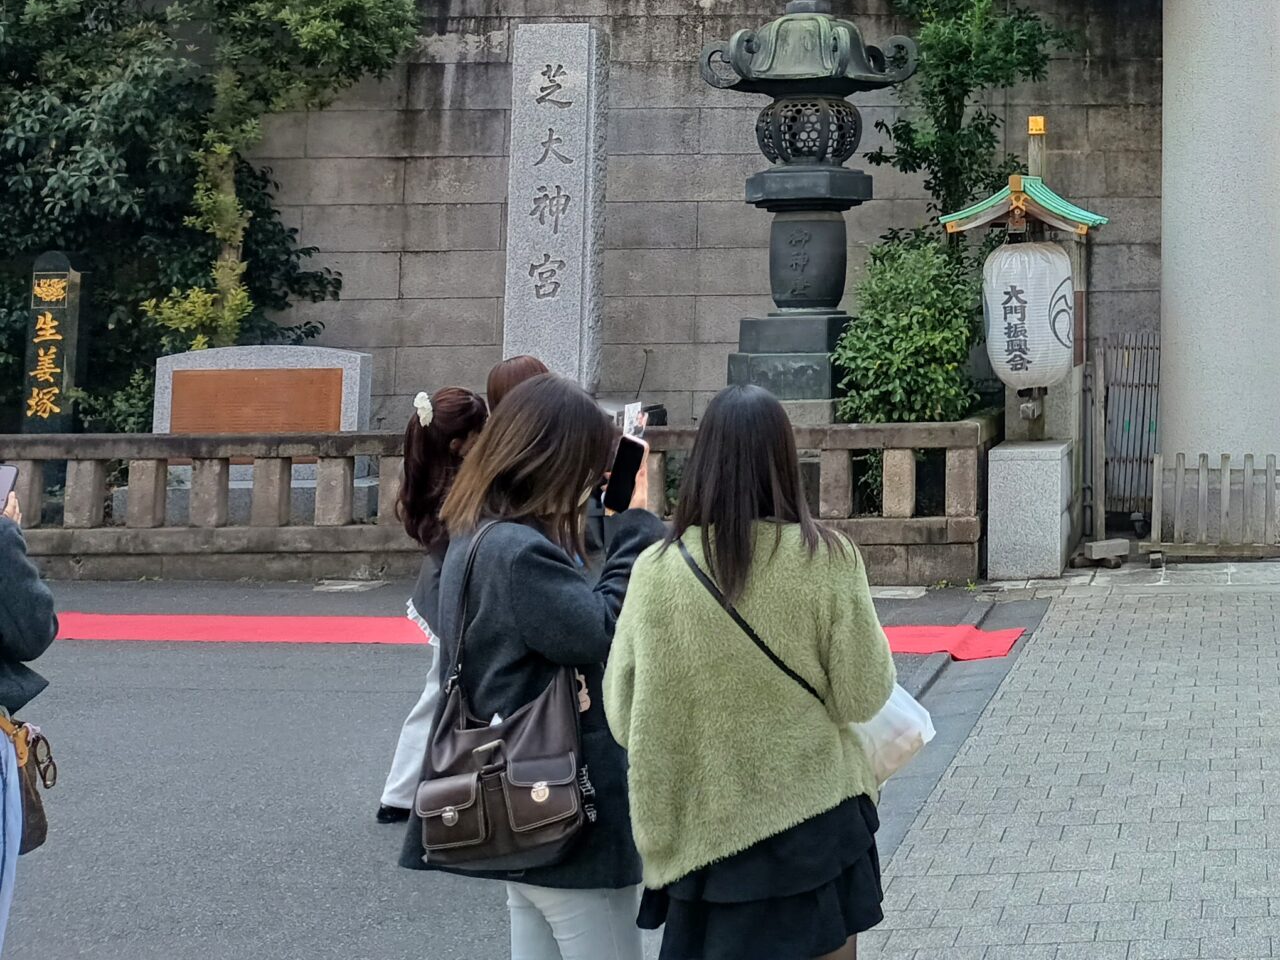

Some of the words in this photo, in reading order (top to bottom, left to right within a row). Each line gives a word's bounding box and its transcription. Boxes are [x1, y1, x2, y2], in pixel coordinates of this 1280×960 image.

[528, 63, 573, 299] 芝大神宮
[26, 311, 63, 419] 生姜塚
[1001, 285, 1033, 371] 大門振興会
